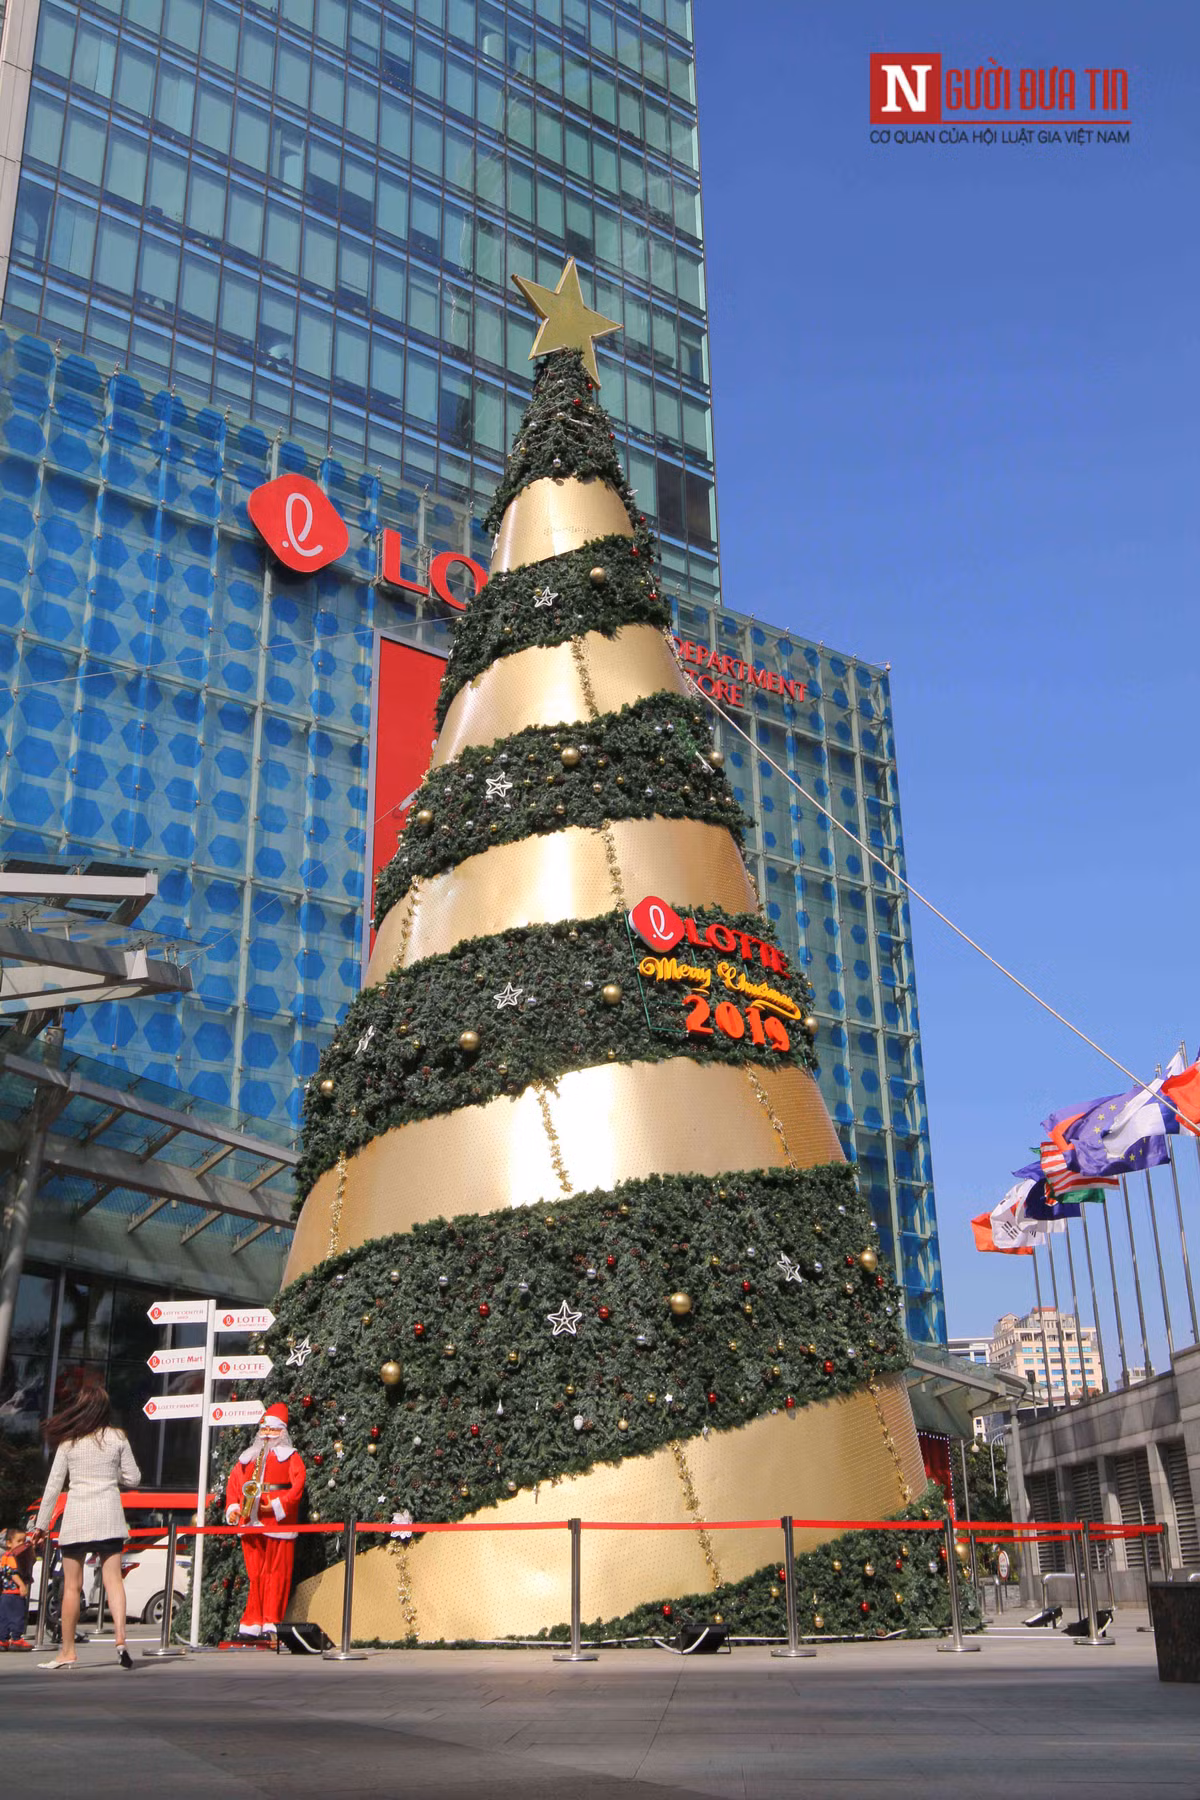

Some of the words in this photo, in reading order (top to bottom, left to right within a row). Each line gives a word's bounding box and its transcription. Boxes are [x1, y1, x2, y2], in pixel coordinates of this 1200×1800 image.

[683, 668, 744, 708] TORE
[684, 917, 791, 979] LOTTE
[638, 956, 712, 995] Merry
[682, 994, 791, 1052] 2019
[187, 1355, 203, 1363] Mart
